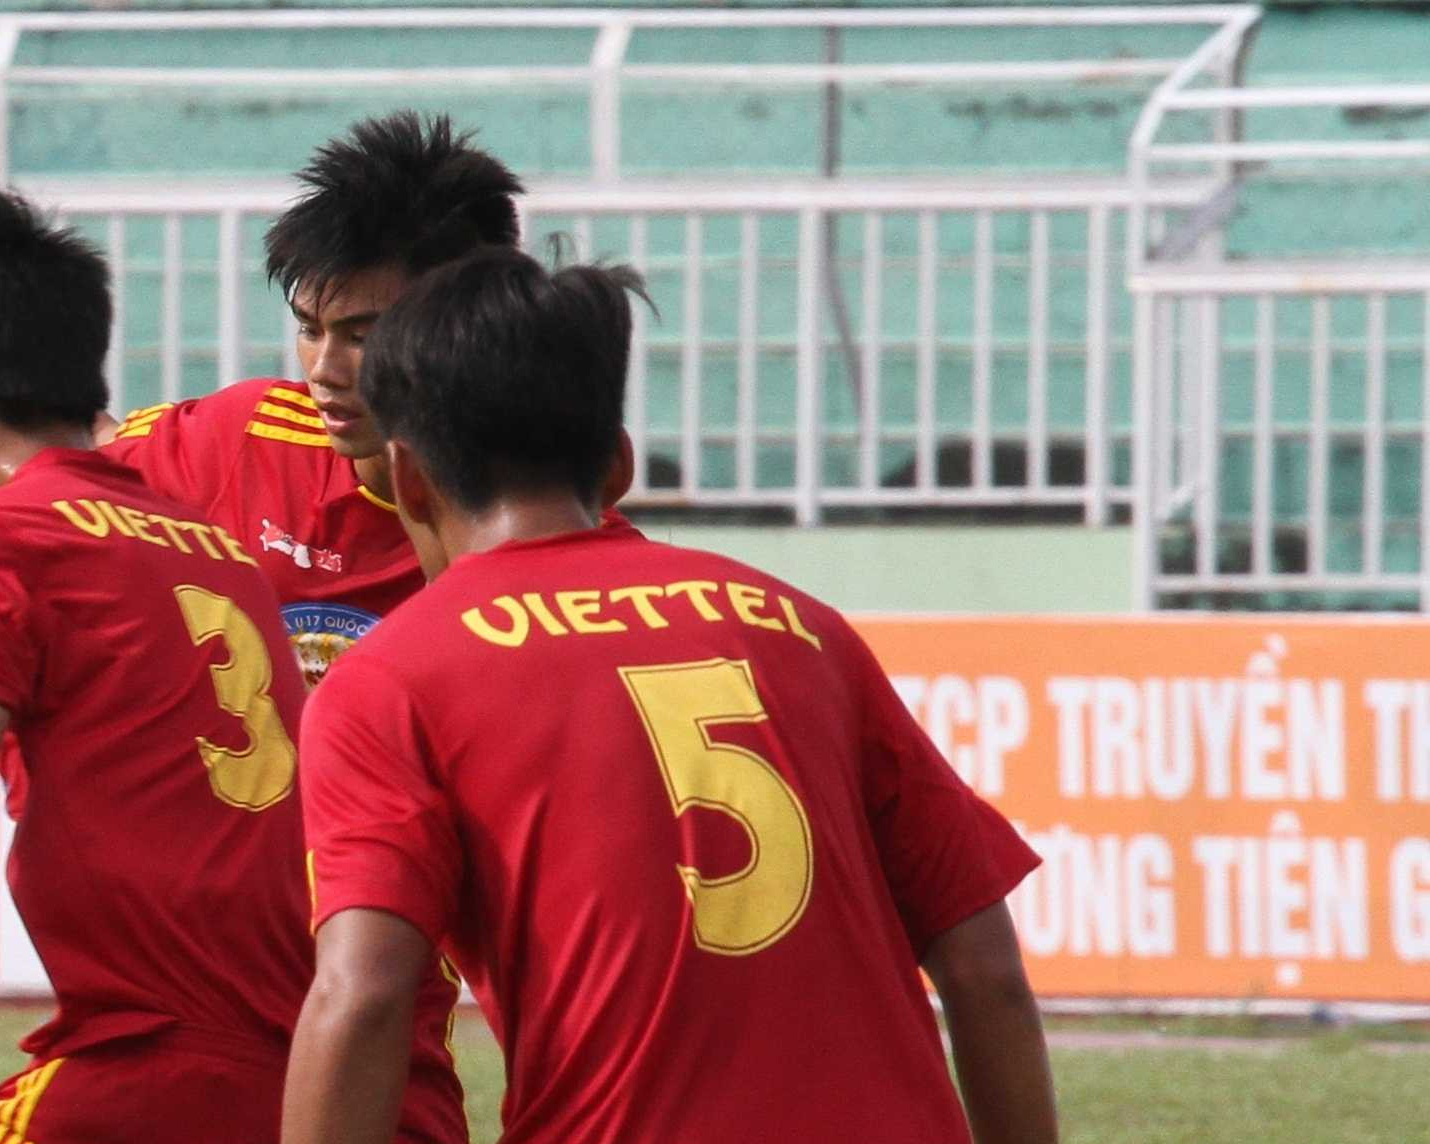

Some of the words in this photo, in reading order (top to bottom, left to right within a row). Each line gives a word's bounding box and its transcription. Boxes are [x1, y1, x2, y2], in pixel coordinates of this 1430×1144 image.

[172, 583, 298, 813] 3
[461, 579, 822, 651] VIETTEL
[1046, 633, 1347, 800] TRUYỀN
[616, 656, 813, 956] 5
[1008, 820, 1177, 958] ƠNG
[1191, 811, 1369, 987] TIỆN
